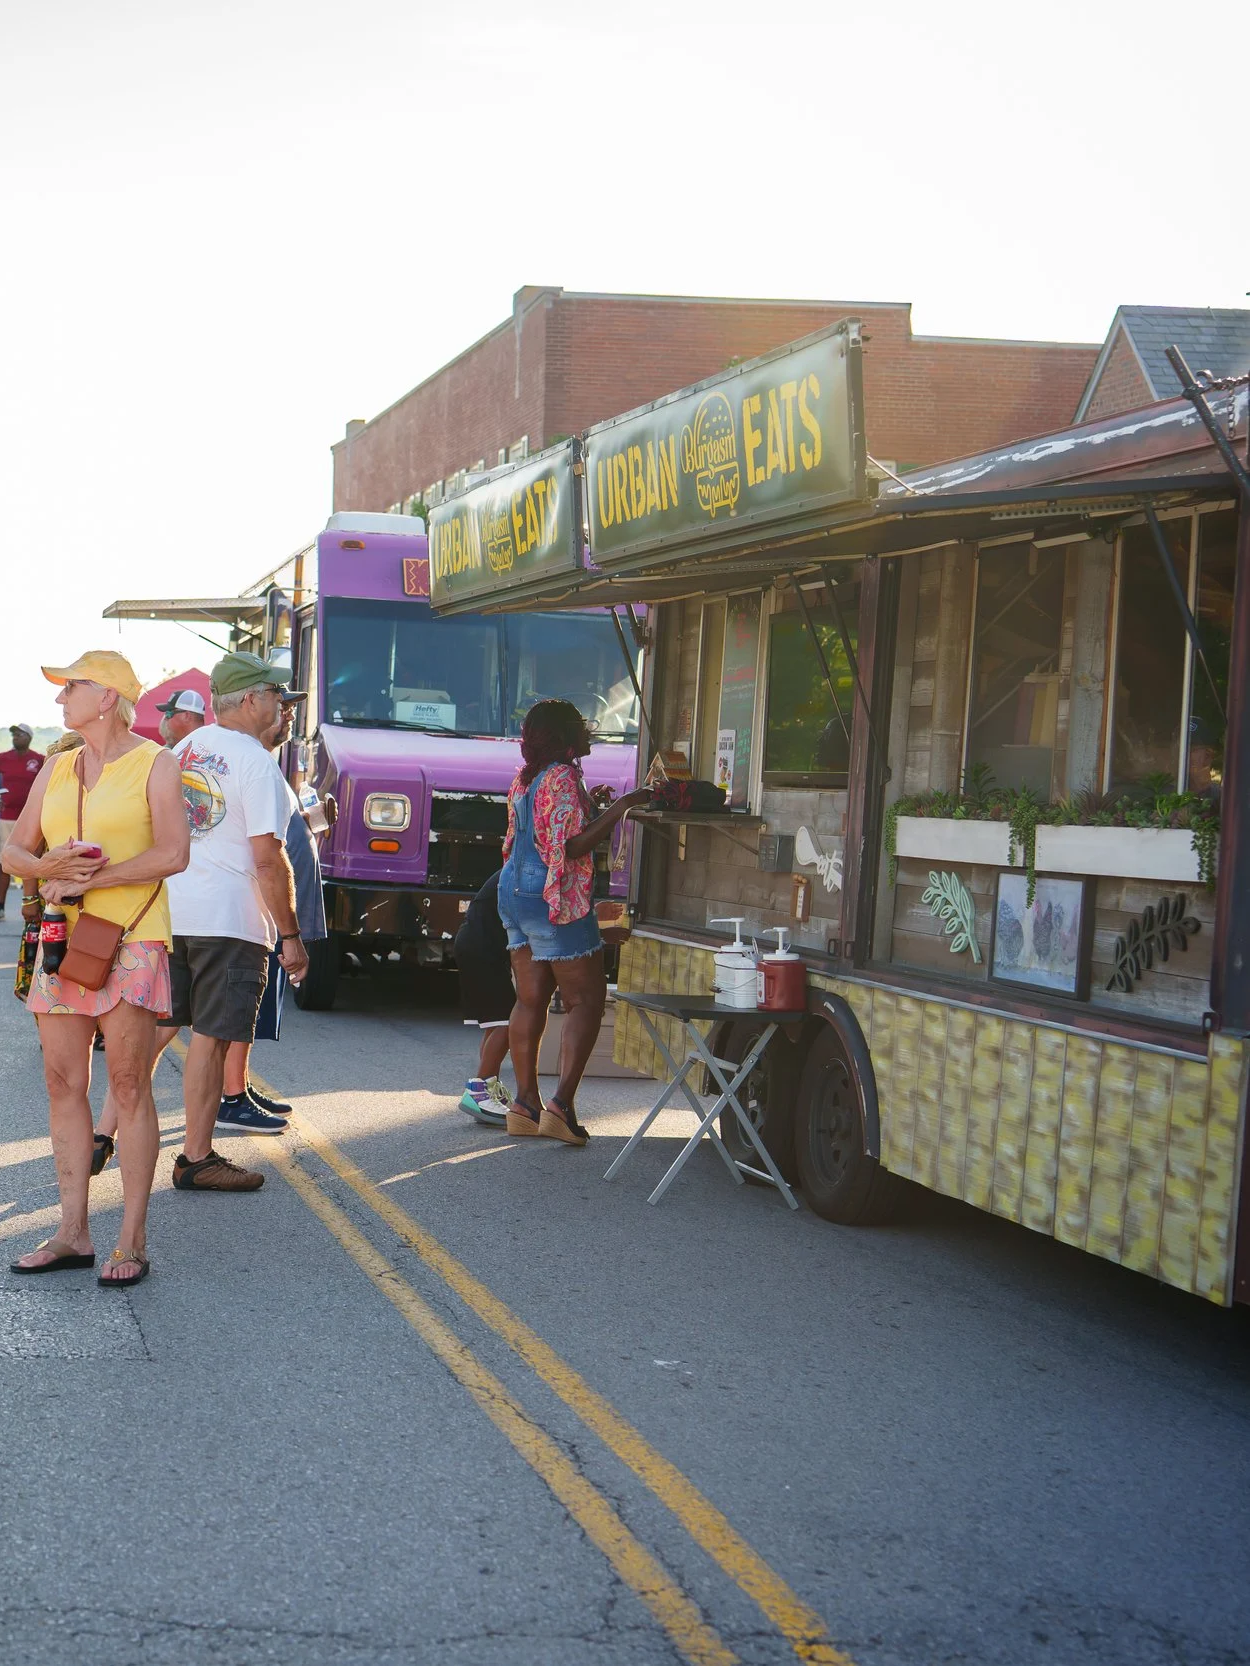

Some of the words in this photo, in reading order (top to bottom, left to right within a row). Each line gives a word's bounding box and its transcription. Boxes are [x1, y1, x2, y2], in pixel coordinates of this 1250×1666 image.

[598, 434, 678, 528] URBAN
[742, 373, 822, 487] EATS
[434, 508, 482, 582] URBAN
[511, 475, 558, 556] EATS
[415, 705, 438, 713] Hefty
